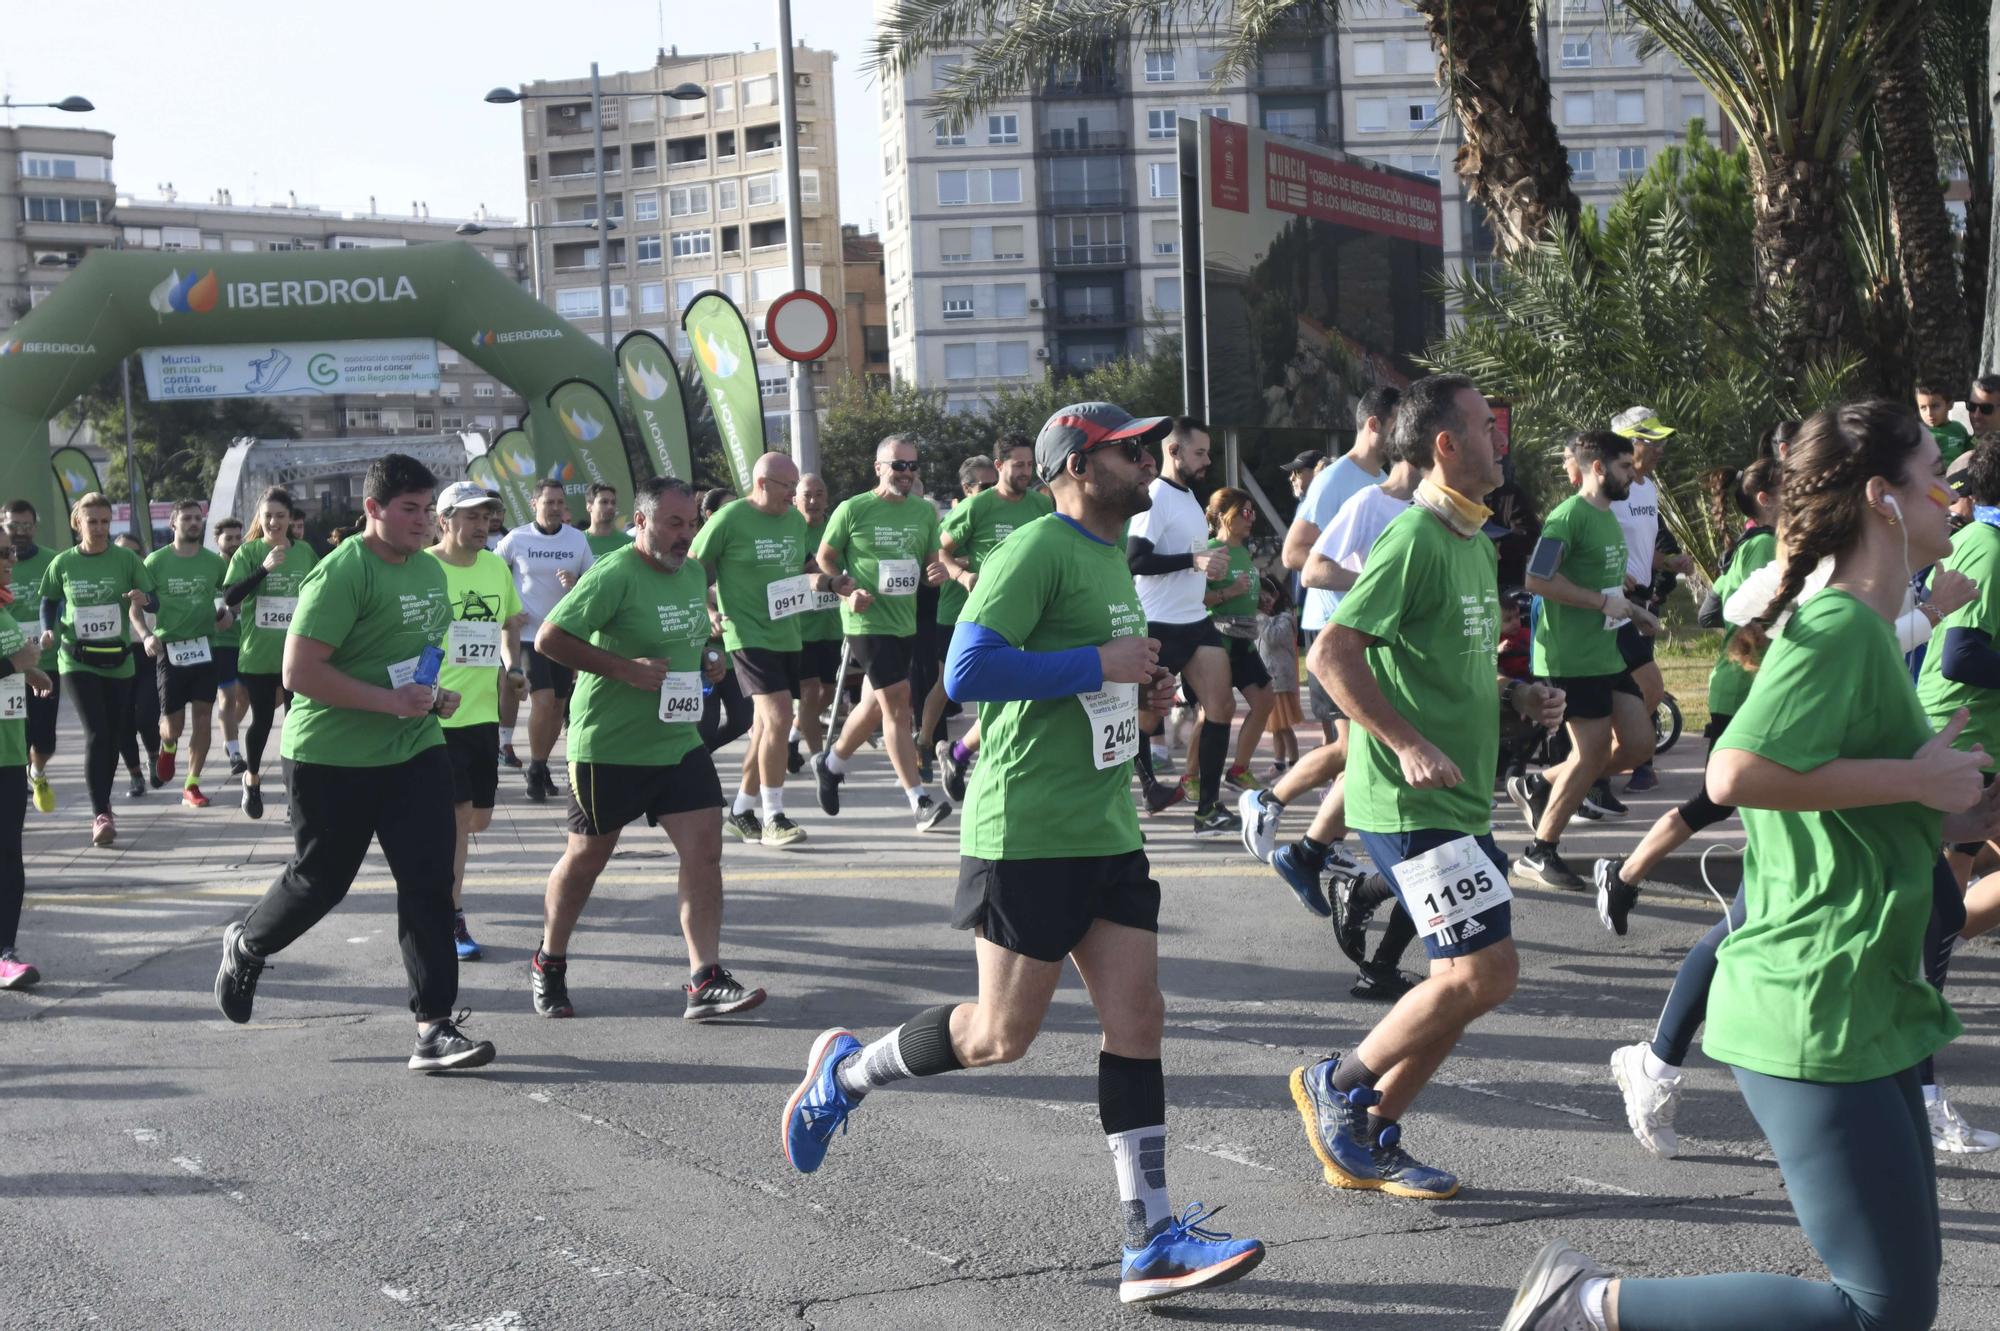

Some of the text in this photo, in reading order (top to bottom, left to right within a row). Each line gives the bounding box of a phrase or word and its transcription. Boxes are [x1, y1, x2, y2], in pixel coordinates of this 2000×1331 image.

[1269, 151, 1306, 183] MURCIA
[1339, 175, 1350, 193] DE
[1403, 193, 1409, 208] Y
[1410, 195, 1436, 214] MEJORA
[1312, 190, 1323, 206] DE
[1324, 193, 1339, 209] LOS
[1381, 206, 1395, 224] DEL
[226, 275, 418, 309] IBERDROLA
[497, 328, 563, 343] IBERDROLA
[22, 342, 96, 353] IBERDROLA
[161, 354, 201, 365] Murcia
[163, 363, 224, 375] en marcha
[344, 363, 372, 373] contra
[374, 363, 382, 372] el
[163, 375, 201, 385] contra
[345, 373, 356, 383] en
[357, 372, 366, 382] la
[398, 371, 410, 381] de
[164, 383, 175, 394] el
[527, 546, 574, 560] Inforges
[887, 576, 916, 588] 0563
[774, 593, 805, 611] 0917
[262, 611, 293, 623] 1266
[82, 621, 115, 633] 1057
[175, 650, 205, 662] 0254
[458, 643, 496, 657] 1277
[667, 697, 699, 712] 0483
[1103, 716, 1136, 750] 2423
[1424, 870, 1493, 914] 1195
[1461, 924, 1487, 940] adidas
